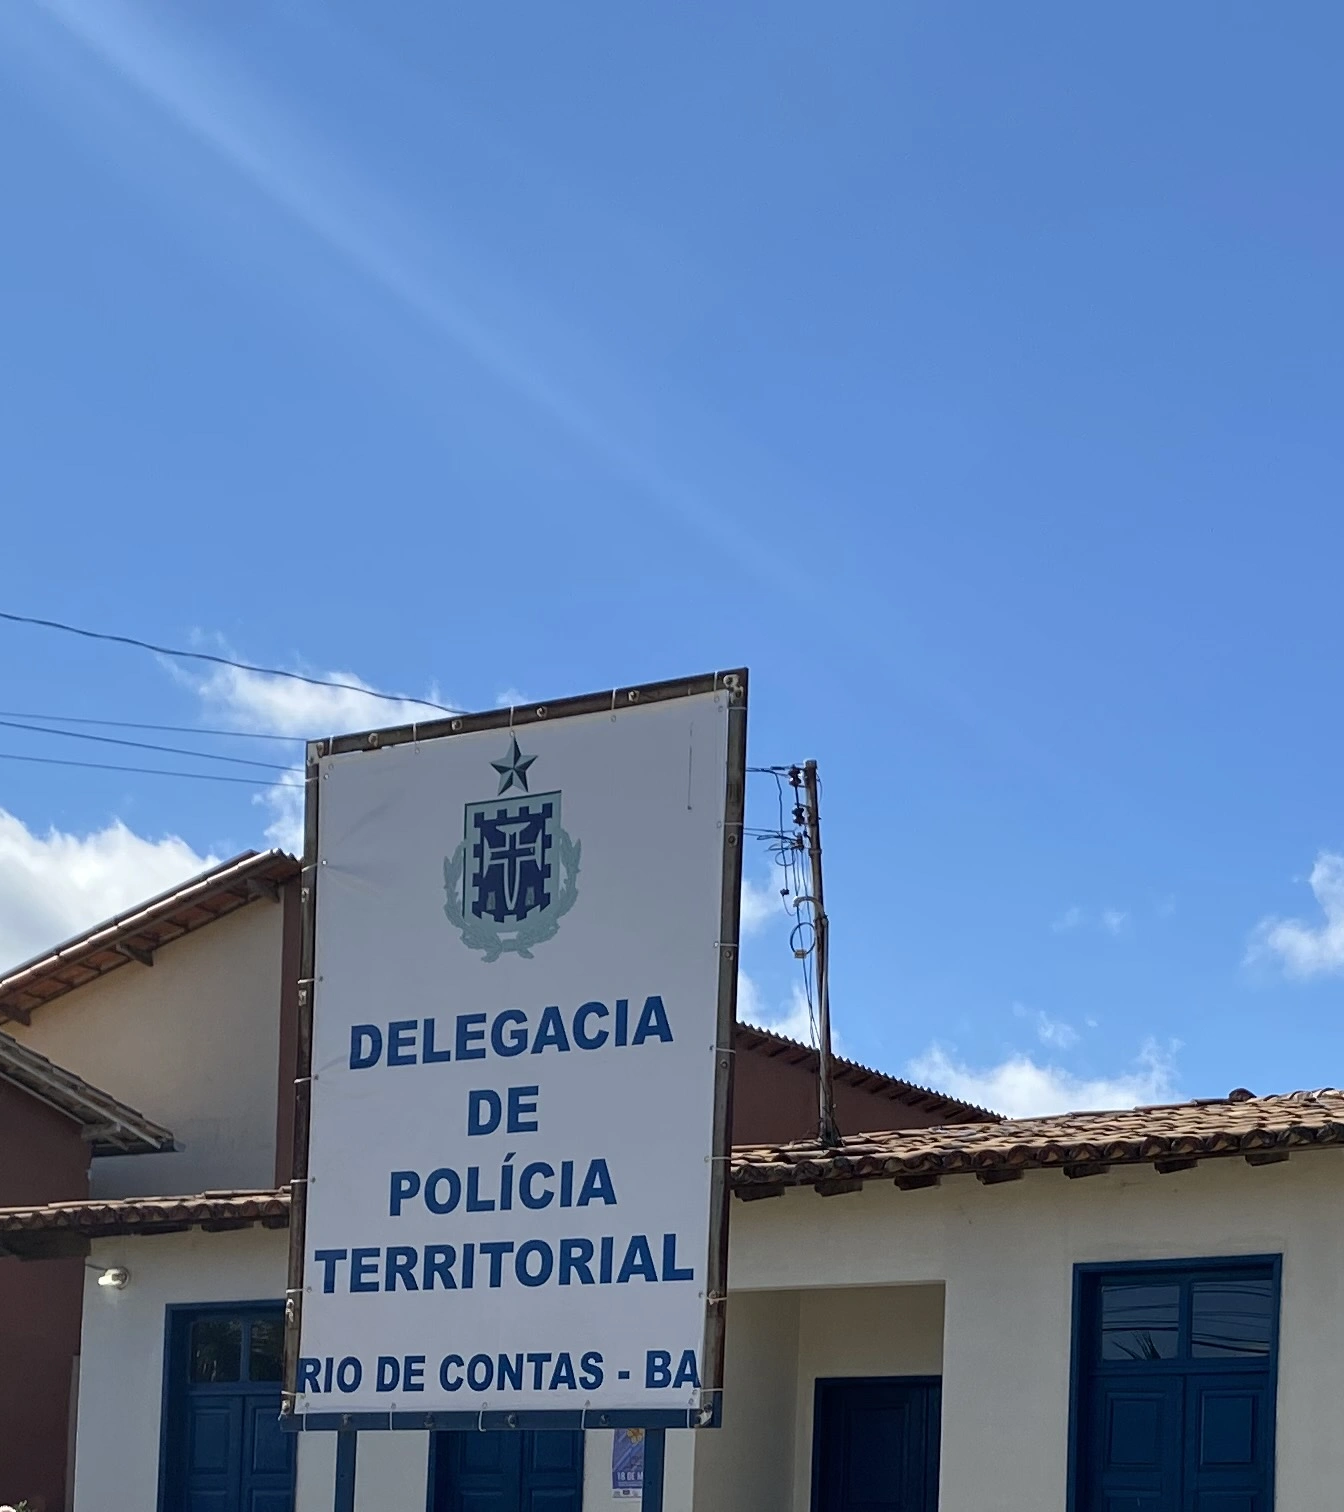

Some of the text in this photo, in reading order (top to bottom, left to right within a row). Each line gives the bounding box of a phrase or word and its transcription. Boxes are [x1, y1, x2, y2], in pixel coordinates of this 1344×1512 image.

[349, 995, 674, 1070] DELEGACIA
[467, 1085, 539, 1136] DE
[389, 1151, 618, 1217] POLÍCIA
[314, 1232, 694, 1294] TERRITORIAL
[297, 1349, 701, 1394] RIO DE CONTAS - BA
[617, 1471, 626, 1481] 18
